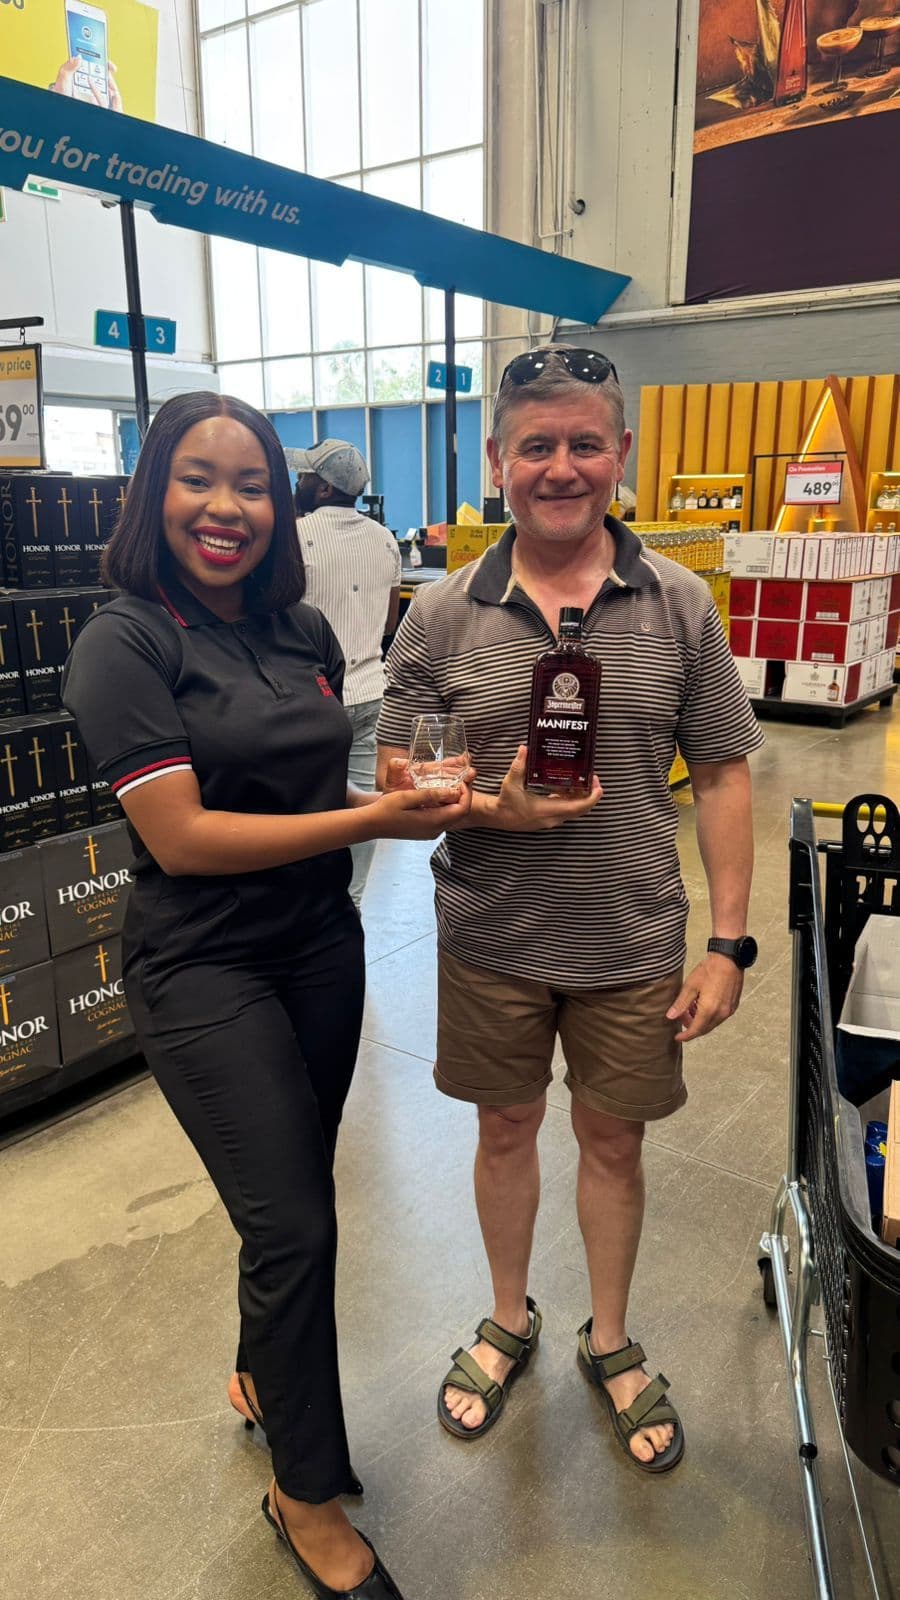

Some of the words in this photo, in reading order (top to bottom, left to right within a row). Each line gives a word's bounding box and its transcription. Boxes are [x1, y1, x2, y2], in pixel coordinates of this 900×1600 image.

[0, 127, 44, 159] ou
[51, 136, 100, 172] for
[105, 153, 209, 206] trading
[215, 185, 268, 216] with
[271, 202, 300, 225] us.
[108, 321, 121, 339] 4
[155, 327, 166, 345] 3
[6, 357, 32, 375] price
[435, 369, 442, 383] 2
[461, 373, 466, 386] 1
[22, 404, 35, 415] 00
[803, 482, 832, 496] 489
[22, 544, 51, 553] HONOR
[54, 543, 81, 552] HONOR
[25, 666, 56, 677] HONOR
[537, 718, 589, 730] MANIFEST
[59, 785, 88, 797] HONOR
[0, 801, 30, 814] HONOR
[57, 868, 134, 905] HONOR
[76, 894, 119, 914] COGNAC
[69, 978, 126, 1015] HONO
[0, 1015, 50, 1046] NOR
